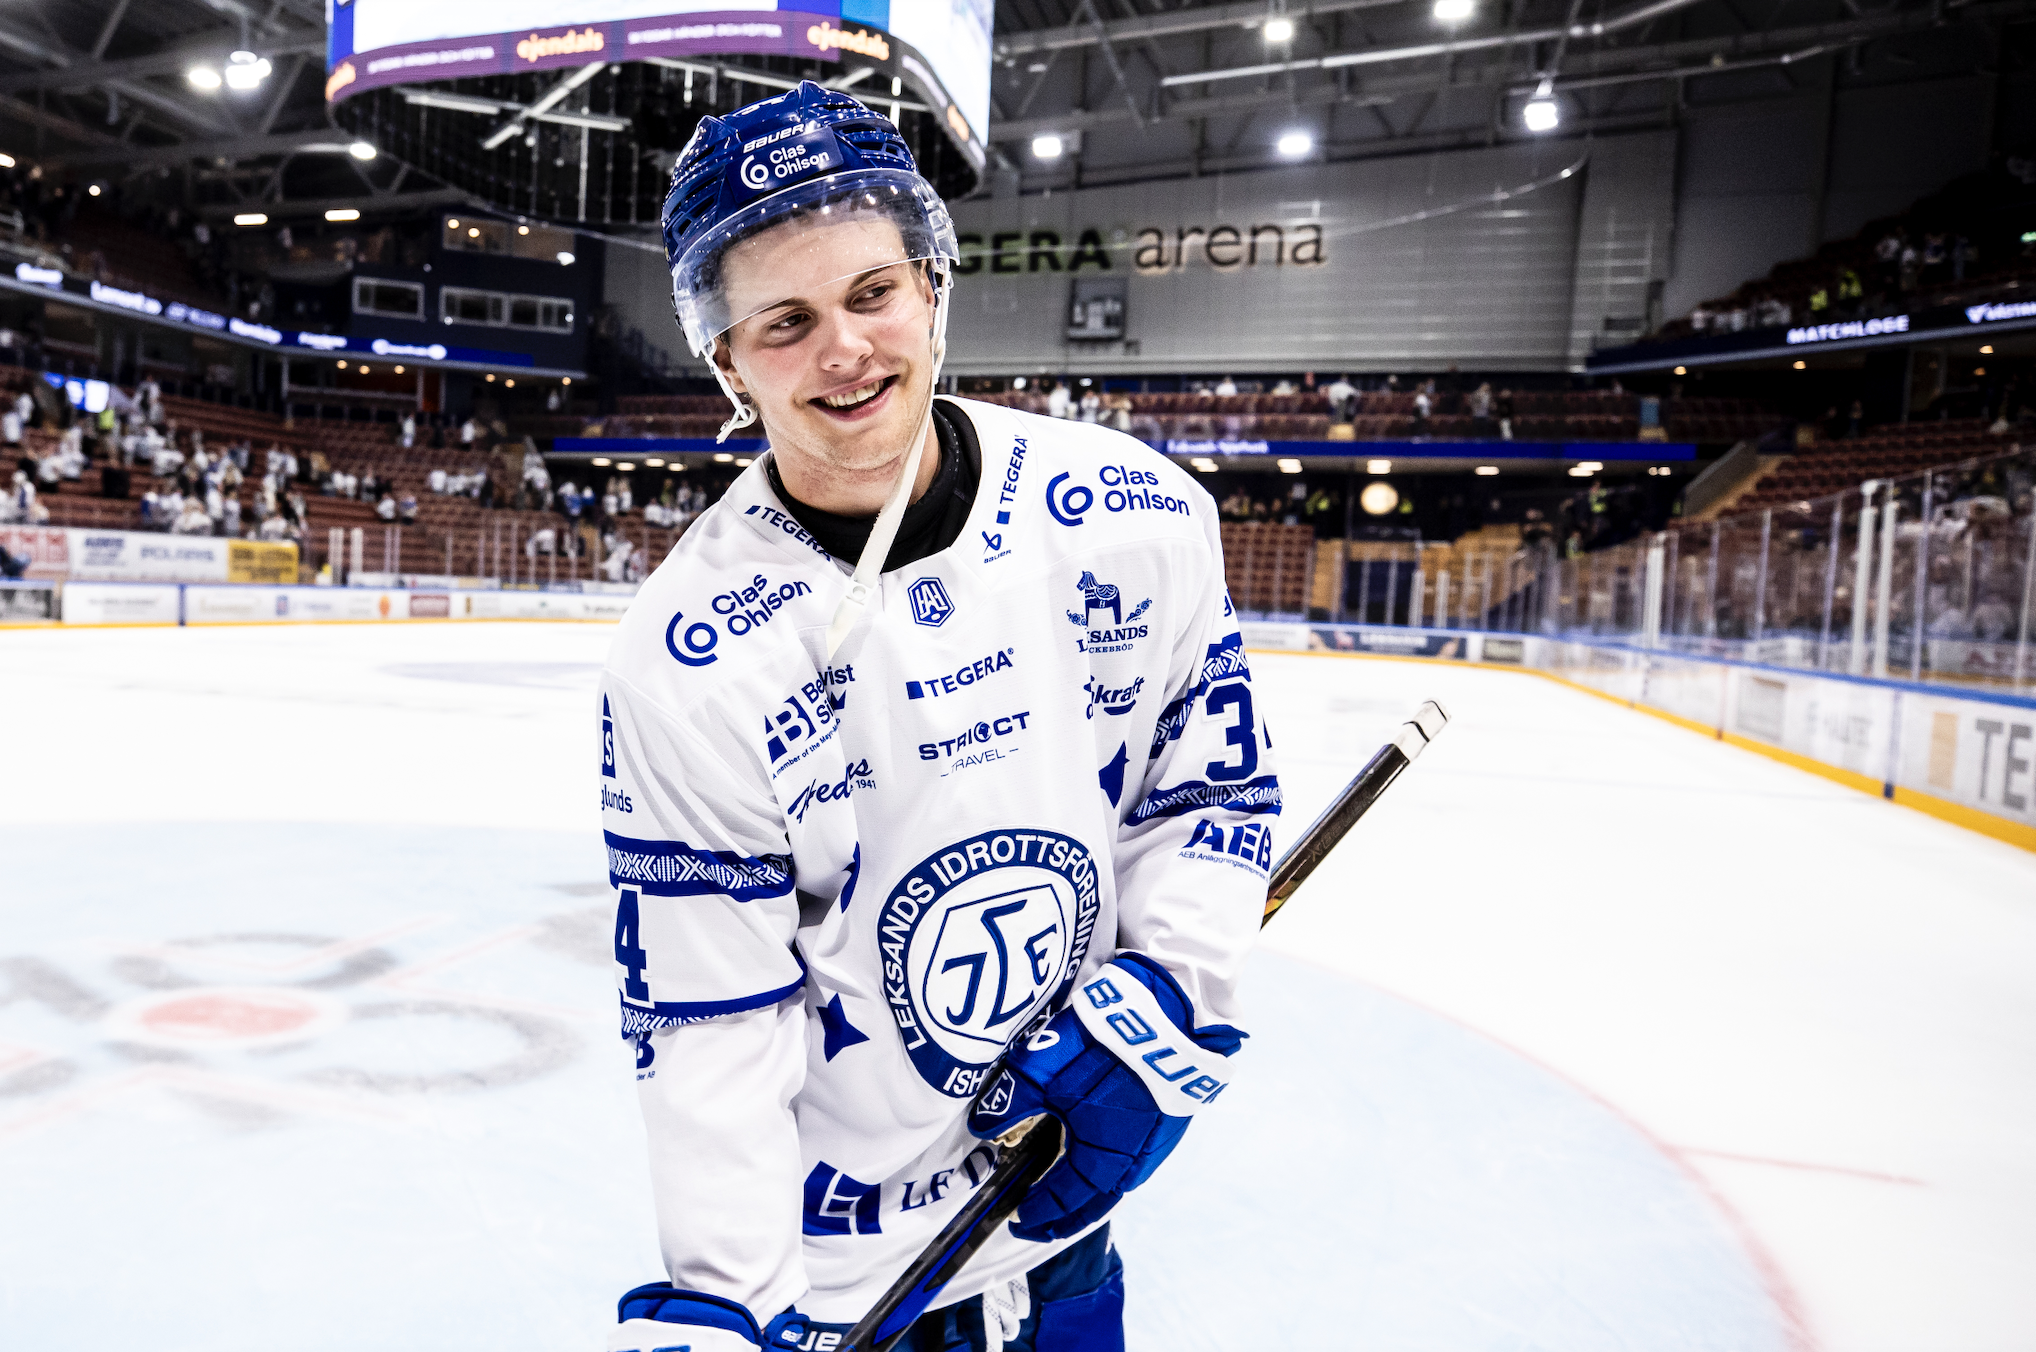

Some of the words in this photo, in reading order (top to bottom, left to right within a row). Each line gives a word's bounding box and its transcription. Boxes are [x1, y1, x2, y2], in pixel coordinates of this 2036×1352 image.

[769, 144, 806, 164] Clas
[774, 151, 830, 178] Ohlson
[1134, 223, 1328, 270] arena
[1099, 465, 1159, 486] Clas
[1104, 488, 1190, 516] Ohlson
[711, 574, 768, 614] Clas
[727, 581, 812, 636] Ohlson
[1076, 625, 1148, 653] LSANDS
[1088, 643, 1133, 654] CKEBRÖD
[801, 664, 856, 704] Bevist
[1093, 676, 1145, 704] kraft
[1205, 682, 1272, 782] 3
[777, 755, 801, 775] member
[802, 748, 809, 758] of
[809, 742, 820, 753] the
[951, 748, 1006, 773] TRAVEL
[1975, 718, 2036, 812] TE
[856, 779, 876, 790] 1941
[1177, 850, 1195, 859] AEB
[1181, 818, 1272, 873] AEB
[882, 876, 936, 1051] LEKSANDS
[930, 834, 1098, 981] IDROTTSFÖRENING
[636, 1031, 655, 1069] B
[900, 1168, 955, 1213] LF
